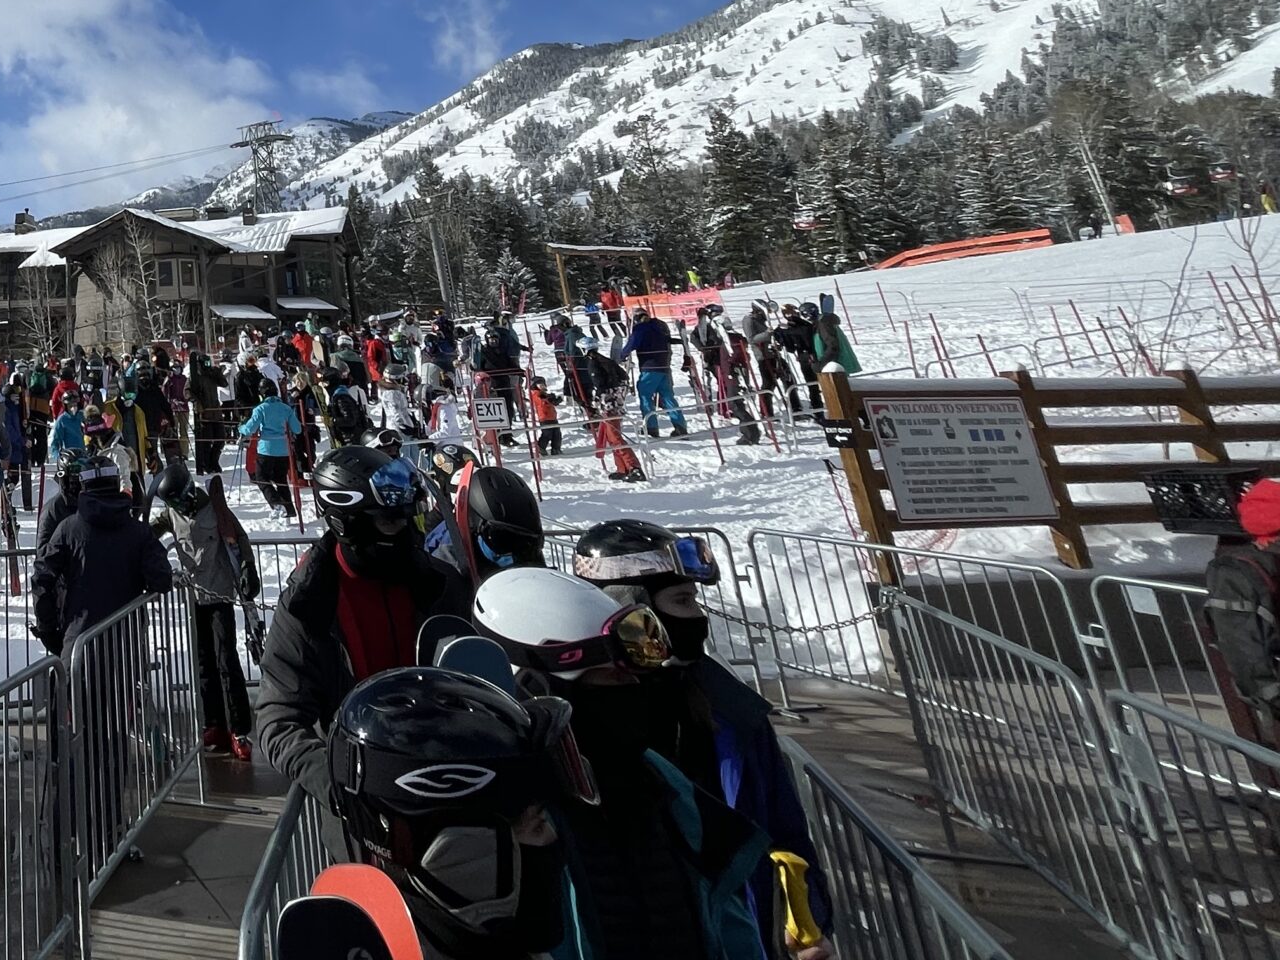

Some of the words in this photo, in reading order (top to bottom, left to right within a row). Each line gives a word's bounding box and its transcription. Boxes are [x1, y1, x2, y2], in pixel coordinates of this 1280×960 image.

[475, 402, 503, 417] EXIT
[891, 403, 941, 414] WELCOME
[941, 403, 955, 414] TO
[956, 403, 1021, 414] SWEETWATER
